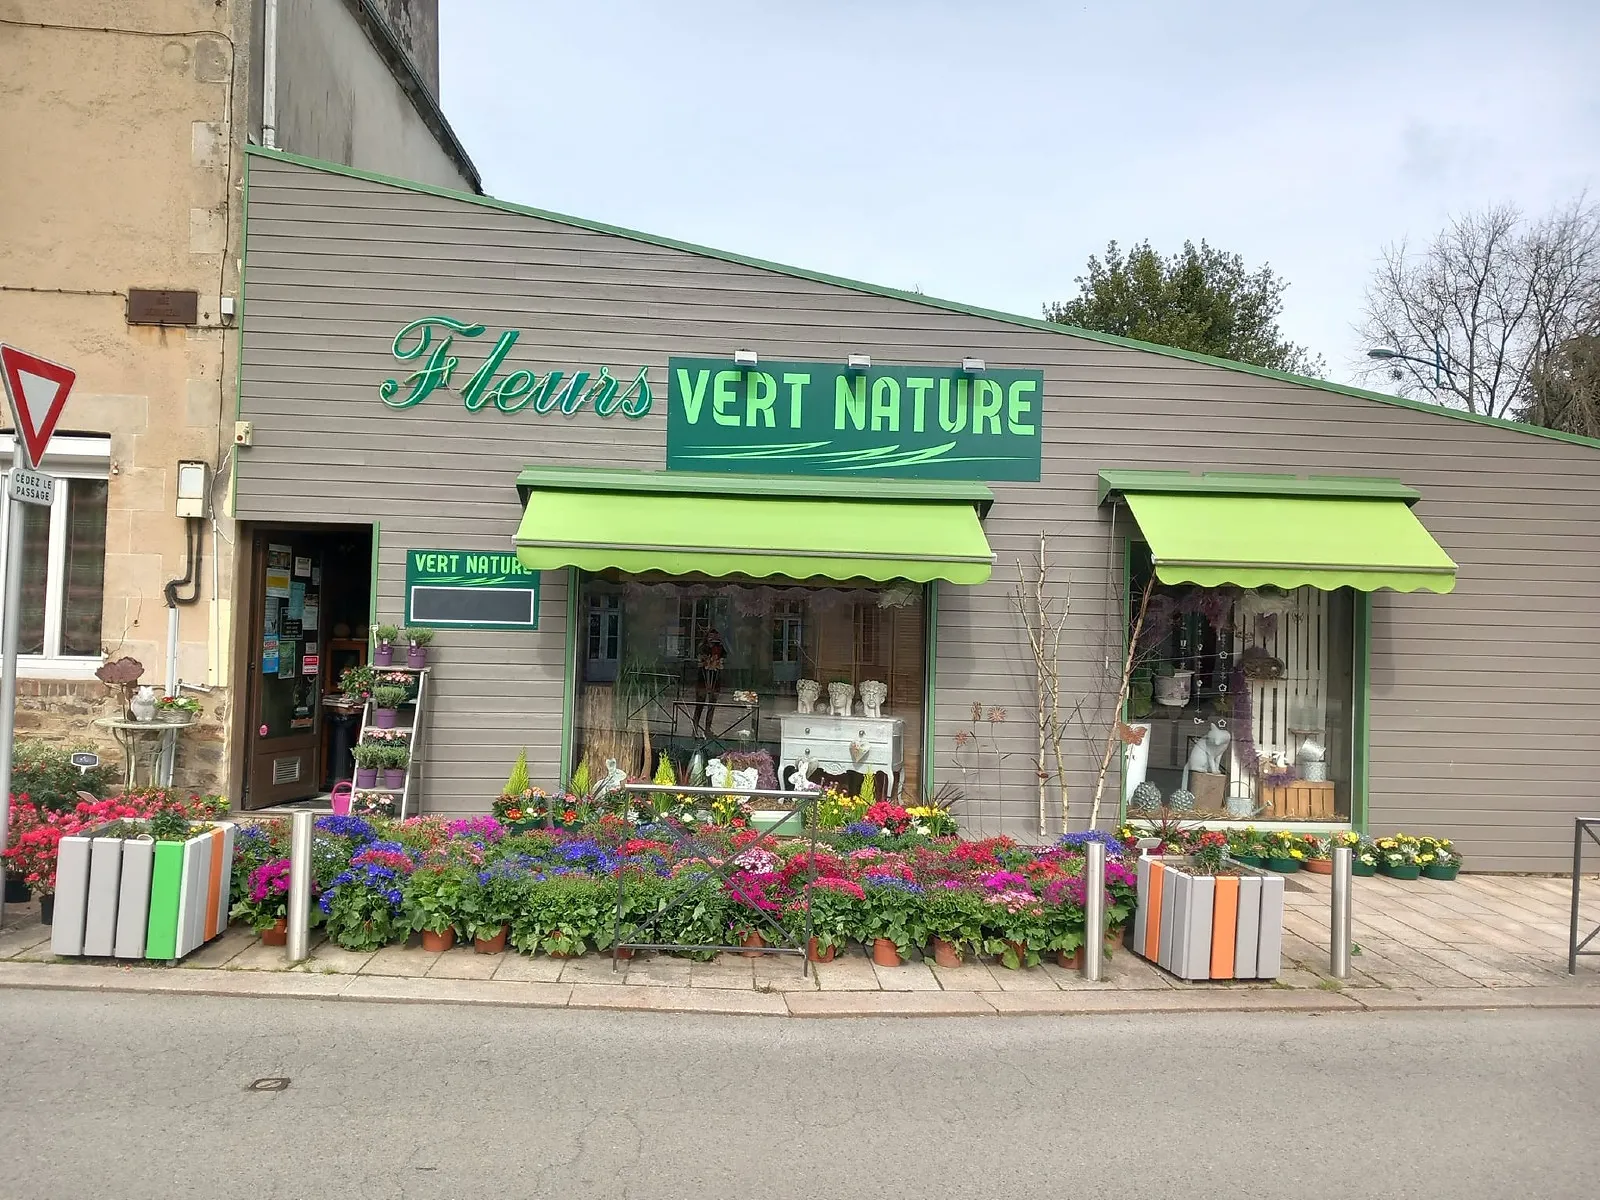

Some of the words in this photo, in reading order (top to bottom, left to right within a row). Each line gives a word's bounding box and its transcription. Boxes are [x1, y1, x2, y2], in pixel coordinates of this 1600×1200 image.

[379, 316, 652, 419] Fleurs
[676, 368, 811, 428] VERT
[834, 375, 1037, 435] NATURE
[15, 472, 40, 487] CÉDEZ
[43, 480, 52, 490] LE
[16, 485, 50, 501] PASSAGE
[415, 553, 459, 573] VERT
